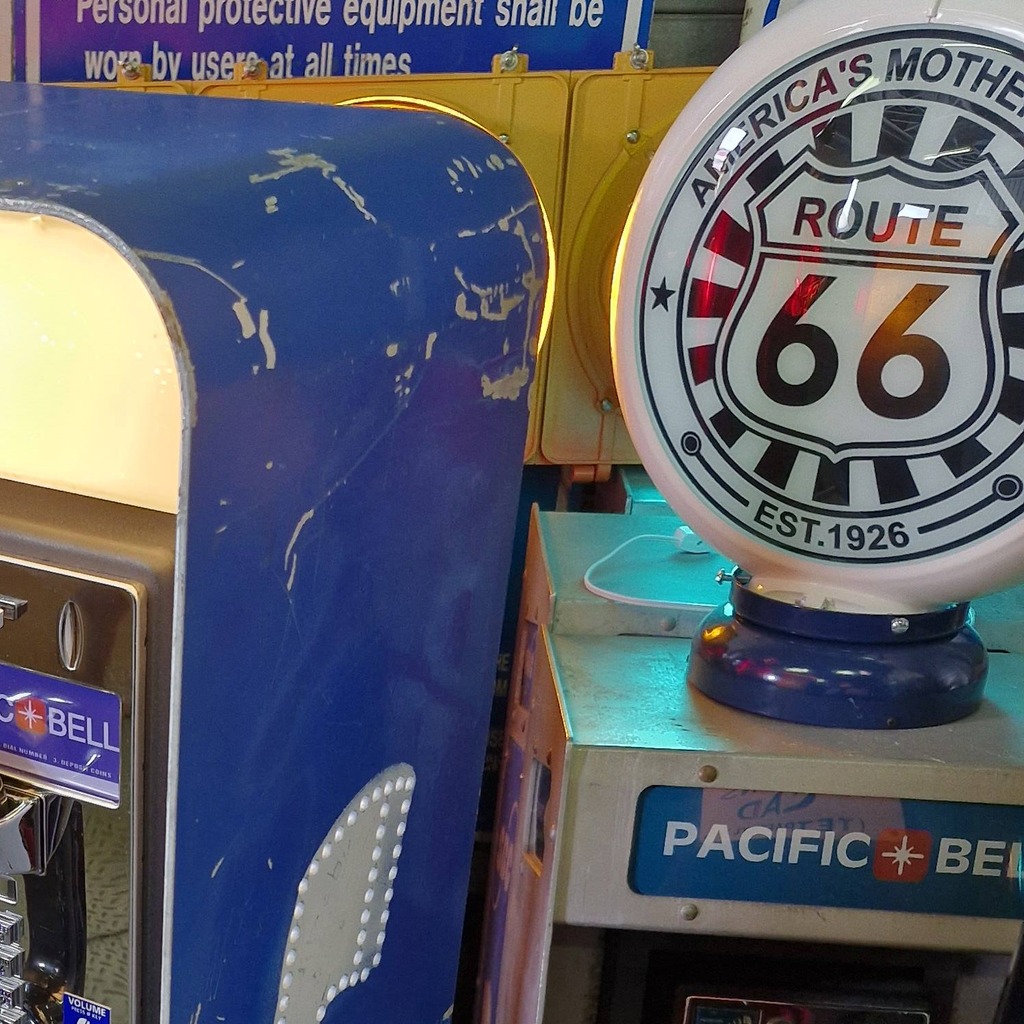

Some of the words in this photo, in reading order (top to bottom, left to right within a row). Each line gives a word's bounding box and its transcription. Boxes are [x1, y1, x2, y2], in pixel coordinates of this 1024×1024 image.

[199, 0, 332, 33] protective
[343, 0, 482, 34] equipment
[495, 0, 556, 27] shall
[568, 0, 604, 27] be
[152, 41, 182, 80] by
[270, 44, 295, 79] at
[305, 42, 333, 77] all
[344, 43, 411, 76] times
[885, 46, 1024, 117] MOTHE
[794, 196, 969, 248] ROUTE
[756, 274, 951, 419] 66
[49, 707, 120, 753] BELL
[3, 743, 17, 752] DIAL
[19, 747, 48, 760] NUMBER
[91, 768, 112, 779] COINS
[663, 821, 872, 869] PACIFIC
[68, 996, 106, 1017] VOLUME
